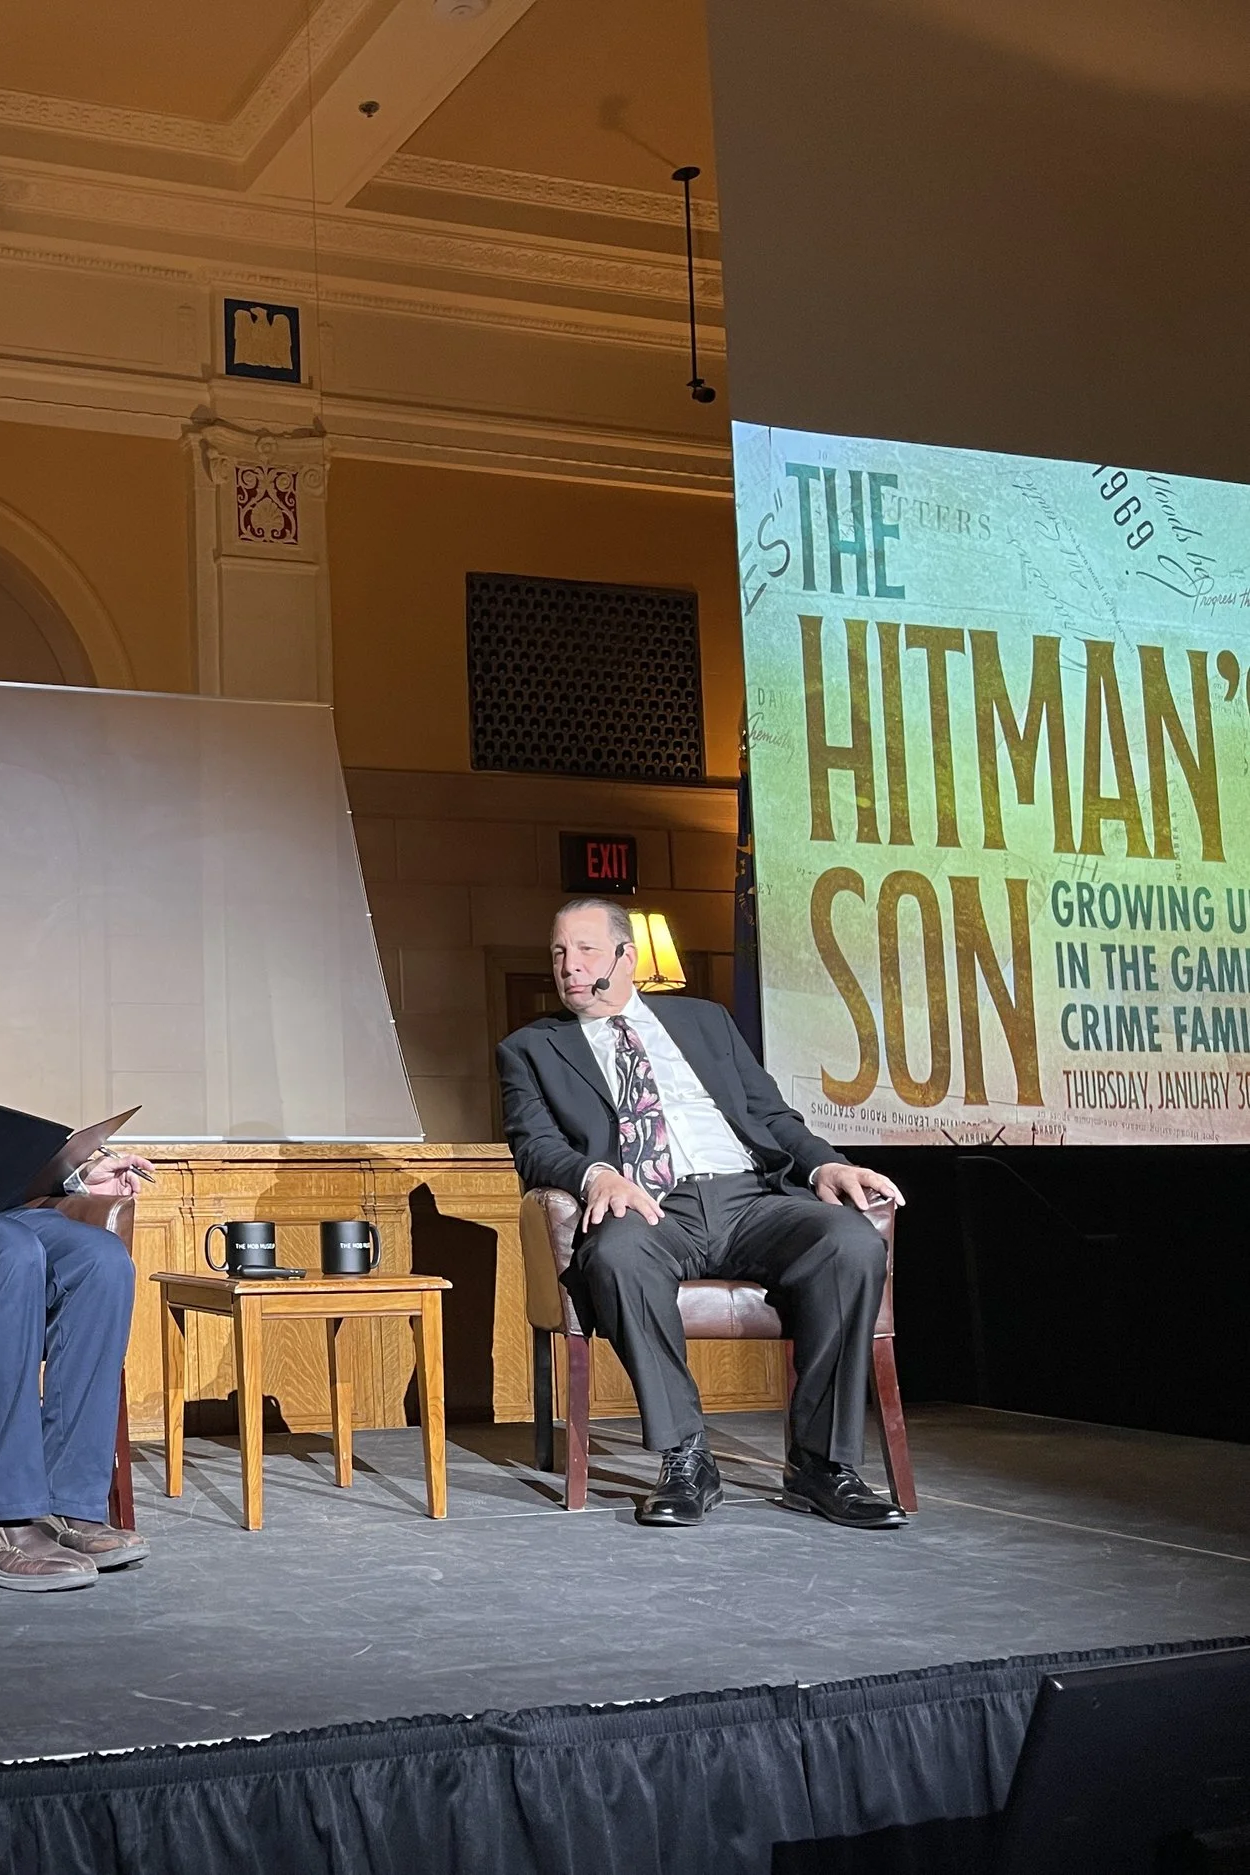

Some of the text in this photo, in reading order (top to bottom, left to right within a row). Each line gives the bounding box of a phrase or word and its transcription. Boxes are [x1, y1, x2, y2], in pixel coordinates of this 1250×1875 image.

[785, 462, 906, 600] THE
[797, 614, 1250, 863] HITMAN'
[586, 842, 629, 880] EXIT
[1051, 880, 1250, 934] GROWING U
[810, 866, 1045, 1108] SON
[1055, 941, 1091, 989] IN
[1100, 943, 1159, 991] THE
[1061, 1003, 1162, 1053] CRIME
[811, 1102, 855, 1119] STATIONS
[860, 1108, 888, 1124] RADIO
[1062, 1069, 1153, 1113] THURSDAY,
[1158, 1071, 1230, 1110] JANUARY
[892, 1111, 930, 1128] LEADING
